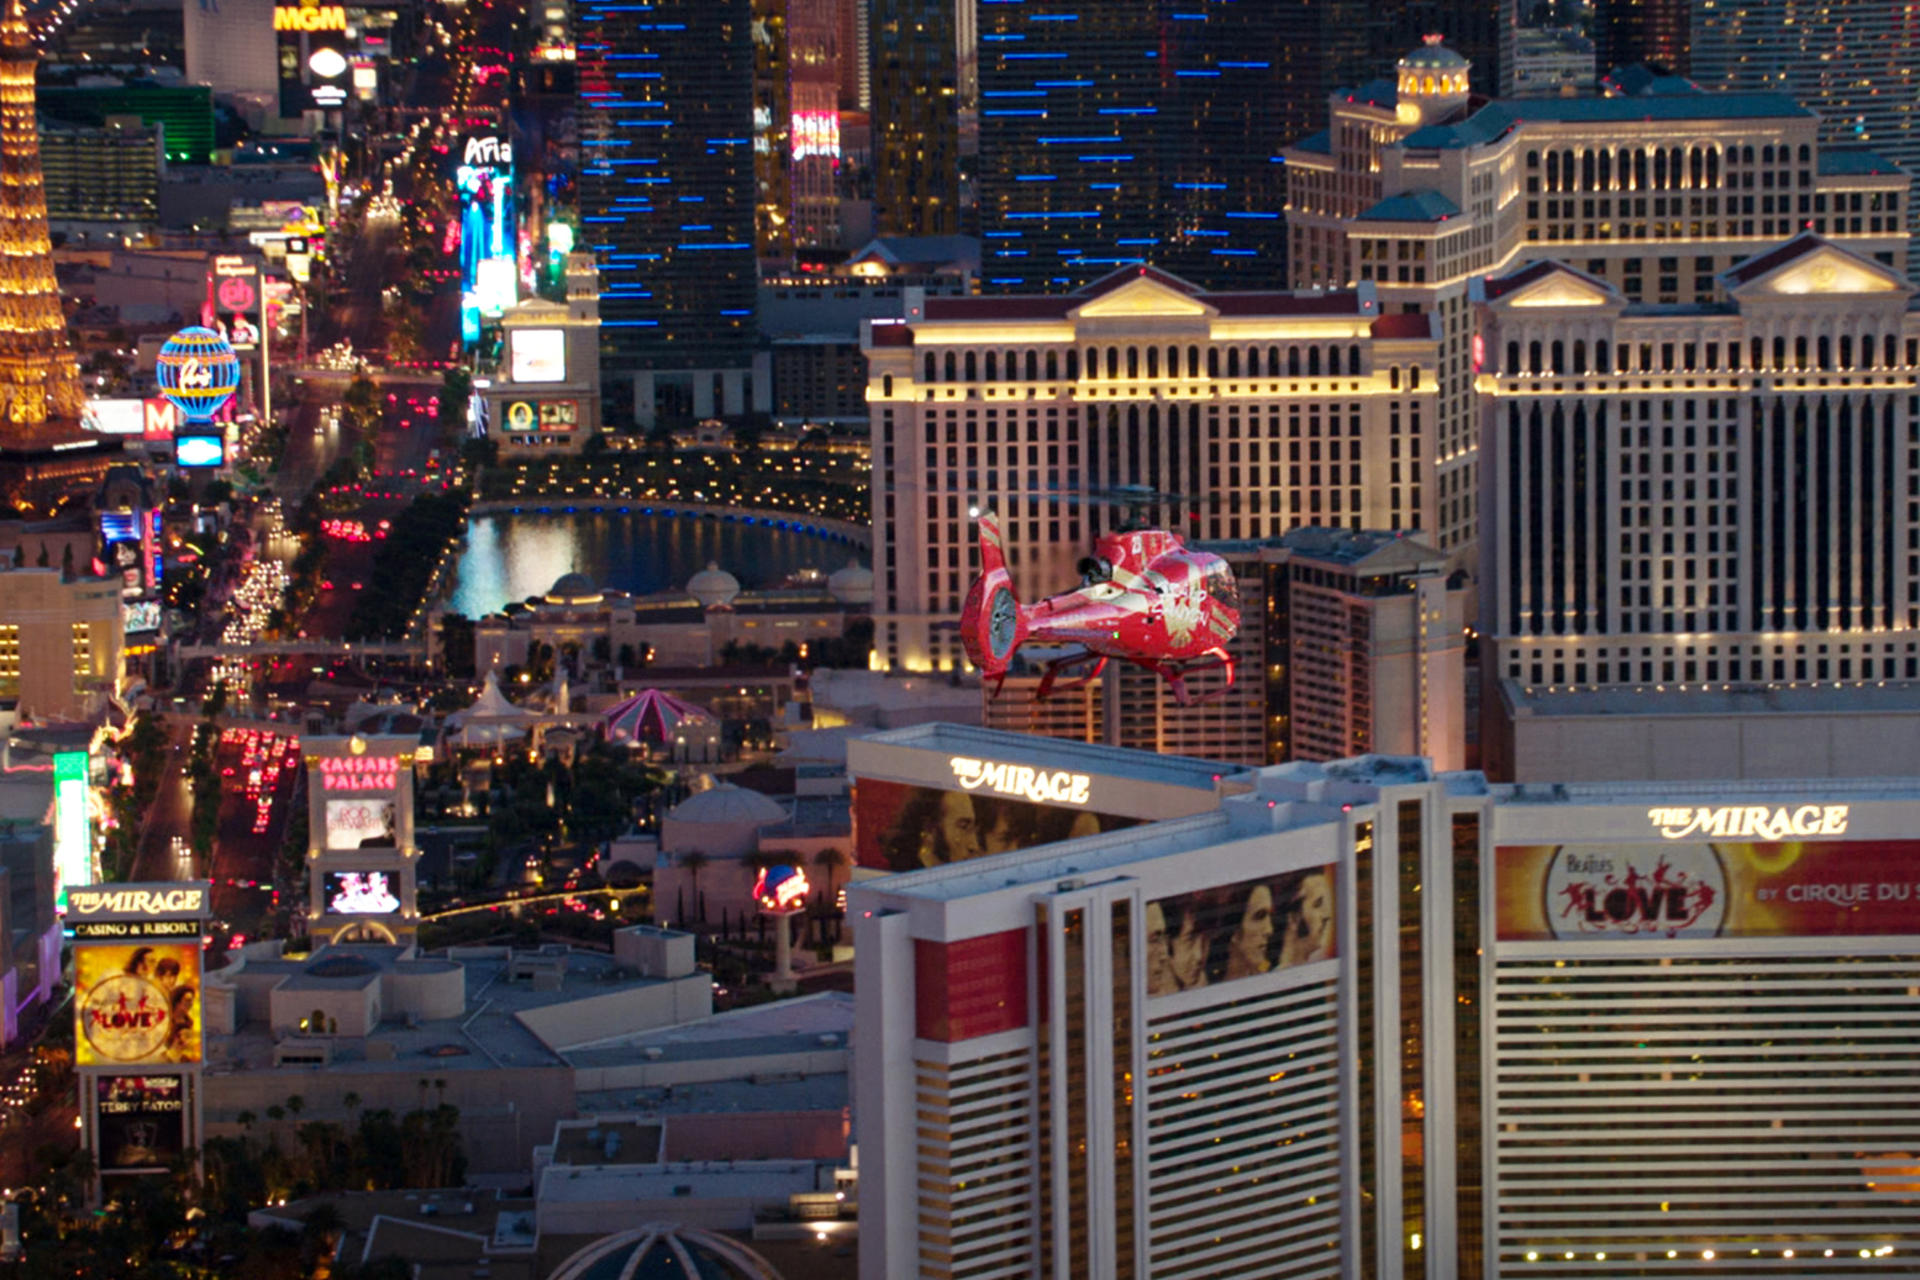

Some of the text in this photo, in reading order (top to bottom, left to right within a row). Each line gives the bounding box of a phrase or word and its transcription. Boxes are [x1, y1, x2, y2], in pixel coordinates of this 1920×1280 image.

[273, 6, 347, 31] MGM
[145, 403, 175, 432] M
[320, 757, 399, 773] CAESARS
[323, 774, 396, 790] PALACE
[950, 757, 1090, 804] THE MIRAGE
[1648, 805, 1850, 840] THE MIRAGE
[78, 890, 202, 914] MIRAGE
[1584, 886, 1690, 922] LOVE
[1786, 883, 1872, 907] CIRQUE
[1876, 883, 1911, 900] DU
[76, 921, 198, 936] CASINO & RESORT
[100, 1010, 152, 1029] LOVE
